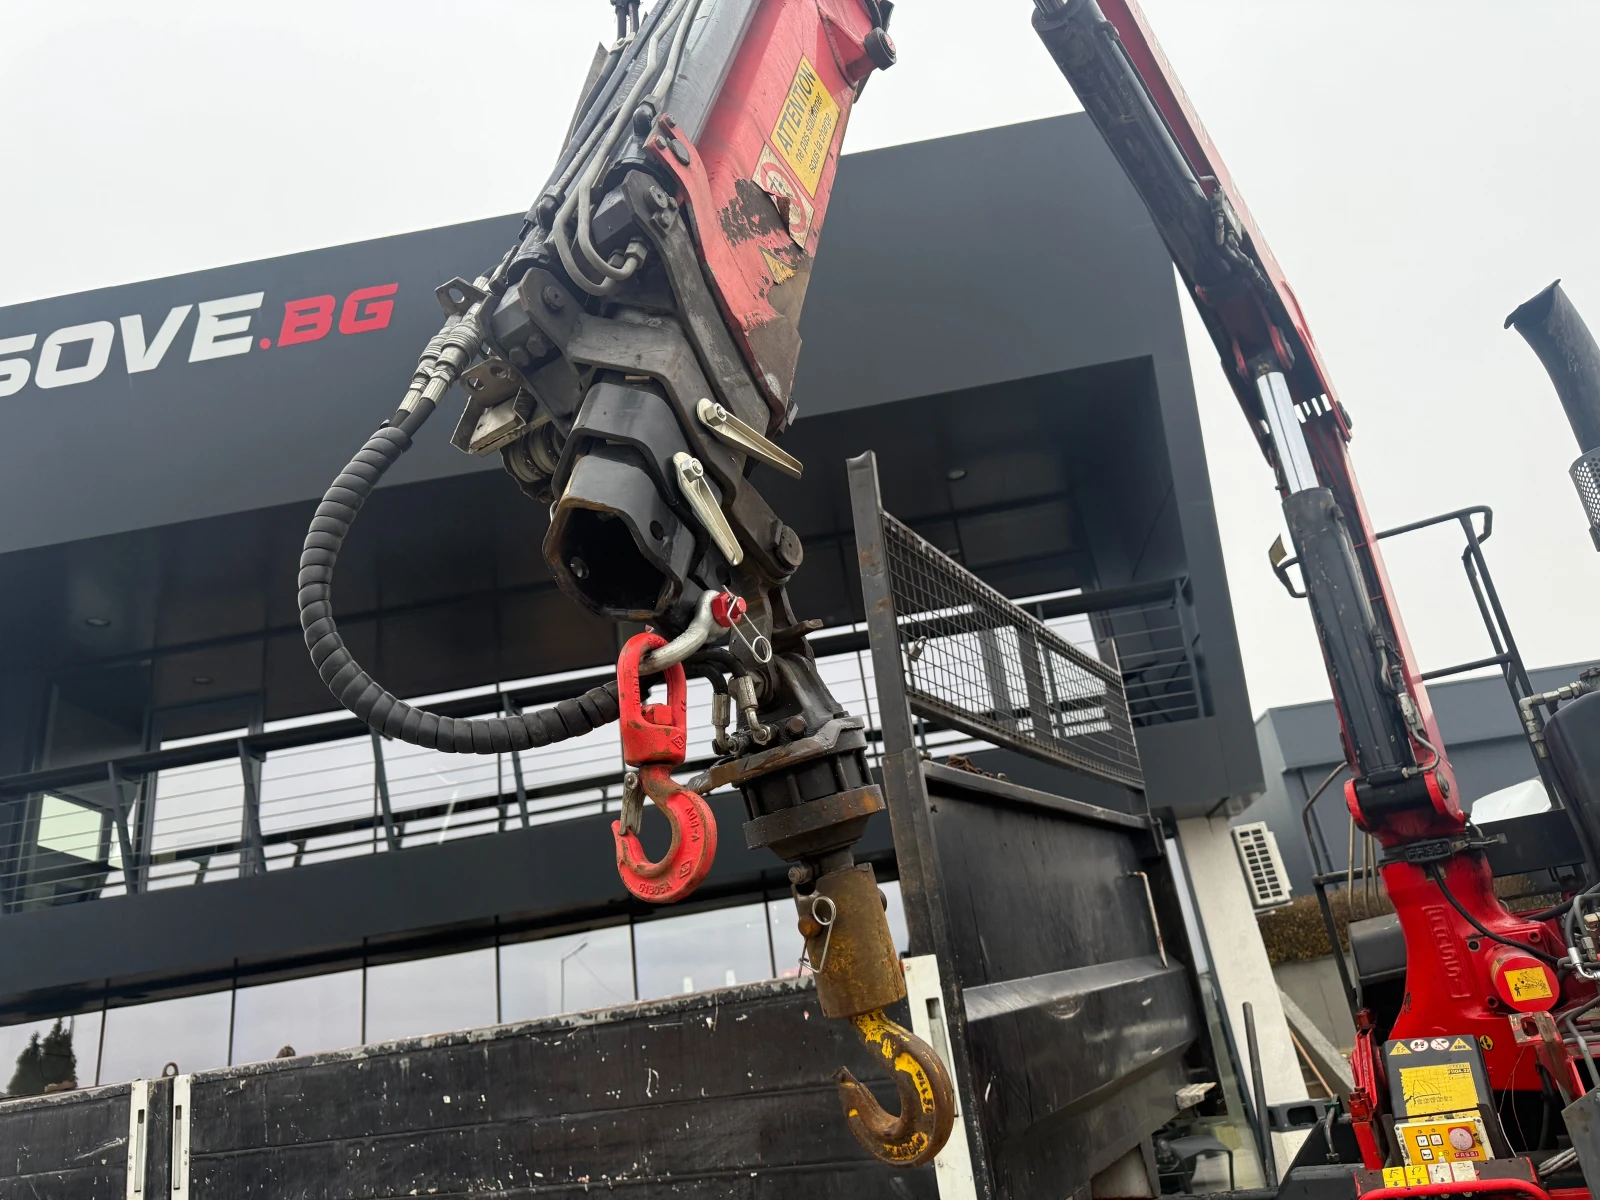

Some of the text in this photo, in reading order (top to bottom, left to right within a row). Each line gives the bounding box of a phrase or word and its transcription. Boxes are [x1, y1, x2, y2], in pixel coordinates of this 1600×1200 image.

[776, 61, 816, 156] ATTENTION
[796, 149, 805, 165] ne
[800, 131, 811, 155] pas
[808, 112, 832, 174] sous la charge
